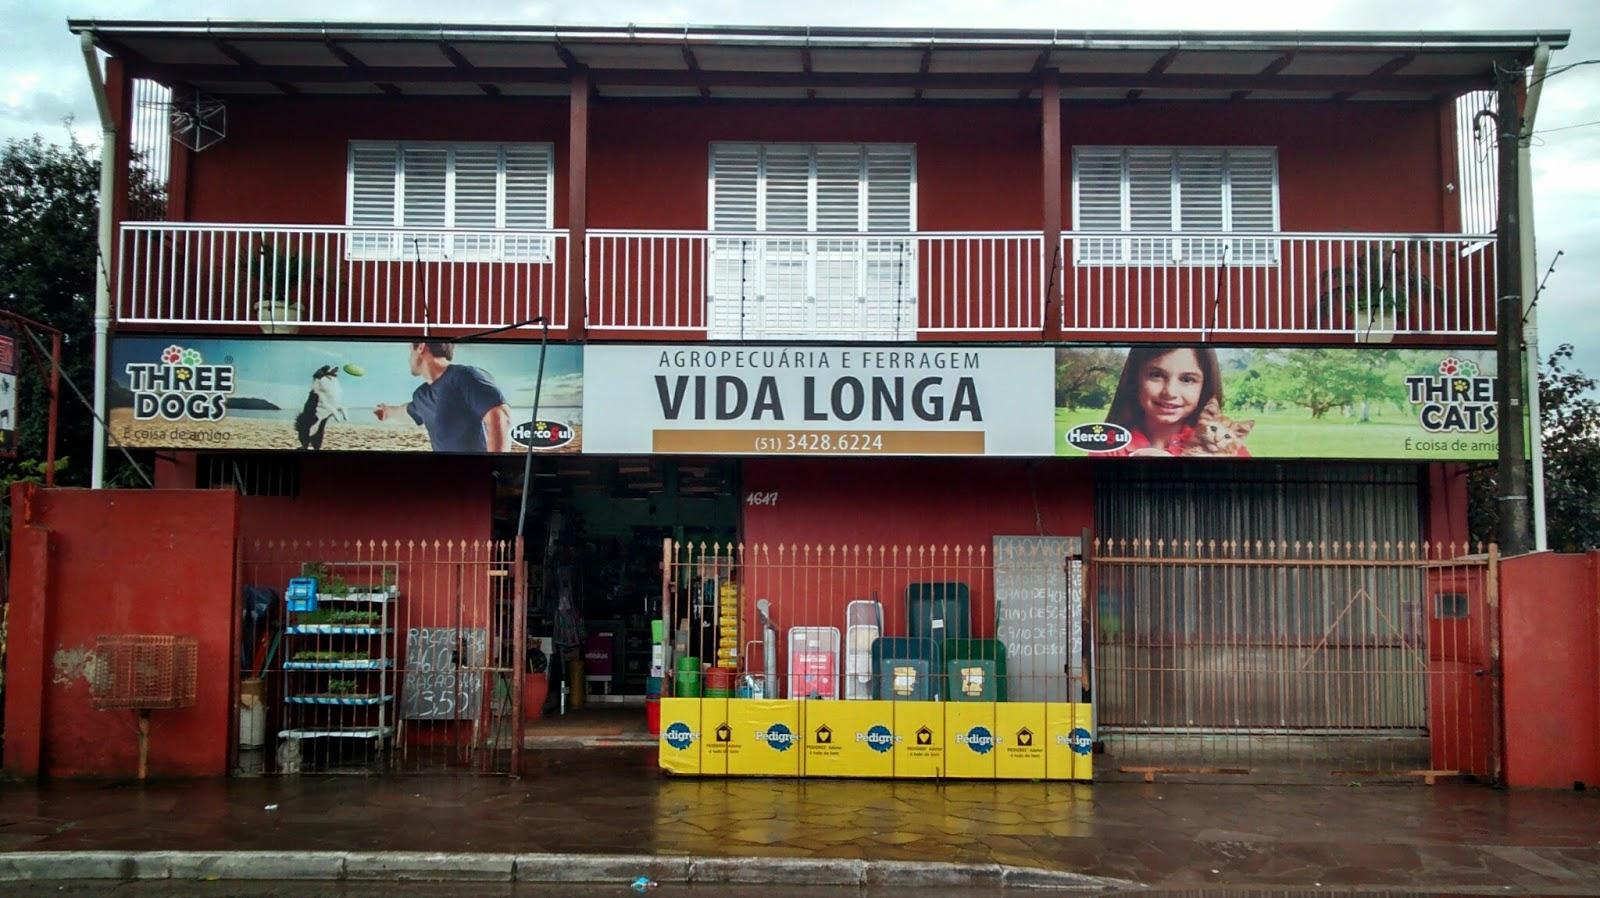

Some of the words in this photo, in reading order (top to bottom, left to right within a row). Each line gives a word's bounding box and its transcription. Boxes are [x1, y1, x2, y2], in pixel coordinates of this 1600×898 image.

[659, 348, 830, 369] AGROPECUÁRIA
[842, 352, 851, 369] E
[863, 352, 979, 369] FERRAGEM
[126, 363, 234, 393] THREE
[134, 392, 227, 421] DOGS
[654, 375, 784, 421] VIDA
[804, 375, 983, 422] LONGA
[1421, 403, 1498, 433] CATS
[134, 428, 166, 440] coisa
[170, 427, 187, 440] de
[188, 428, 231, 443] amigo
[755, 436, 781, 452] (51)
[786, 433, 883, 451] 3428.6224
[1405, 437, 1412, 451] É
[1415, 440, 1448, 451] coisa
[1456, 439, 1469, 451] de
[746, 491, 778, 506] 4647
